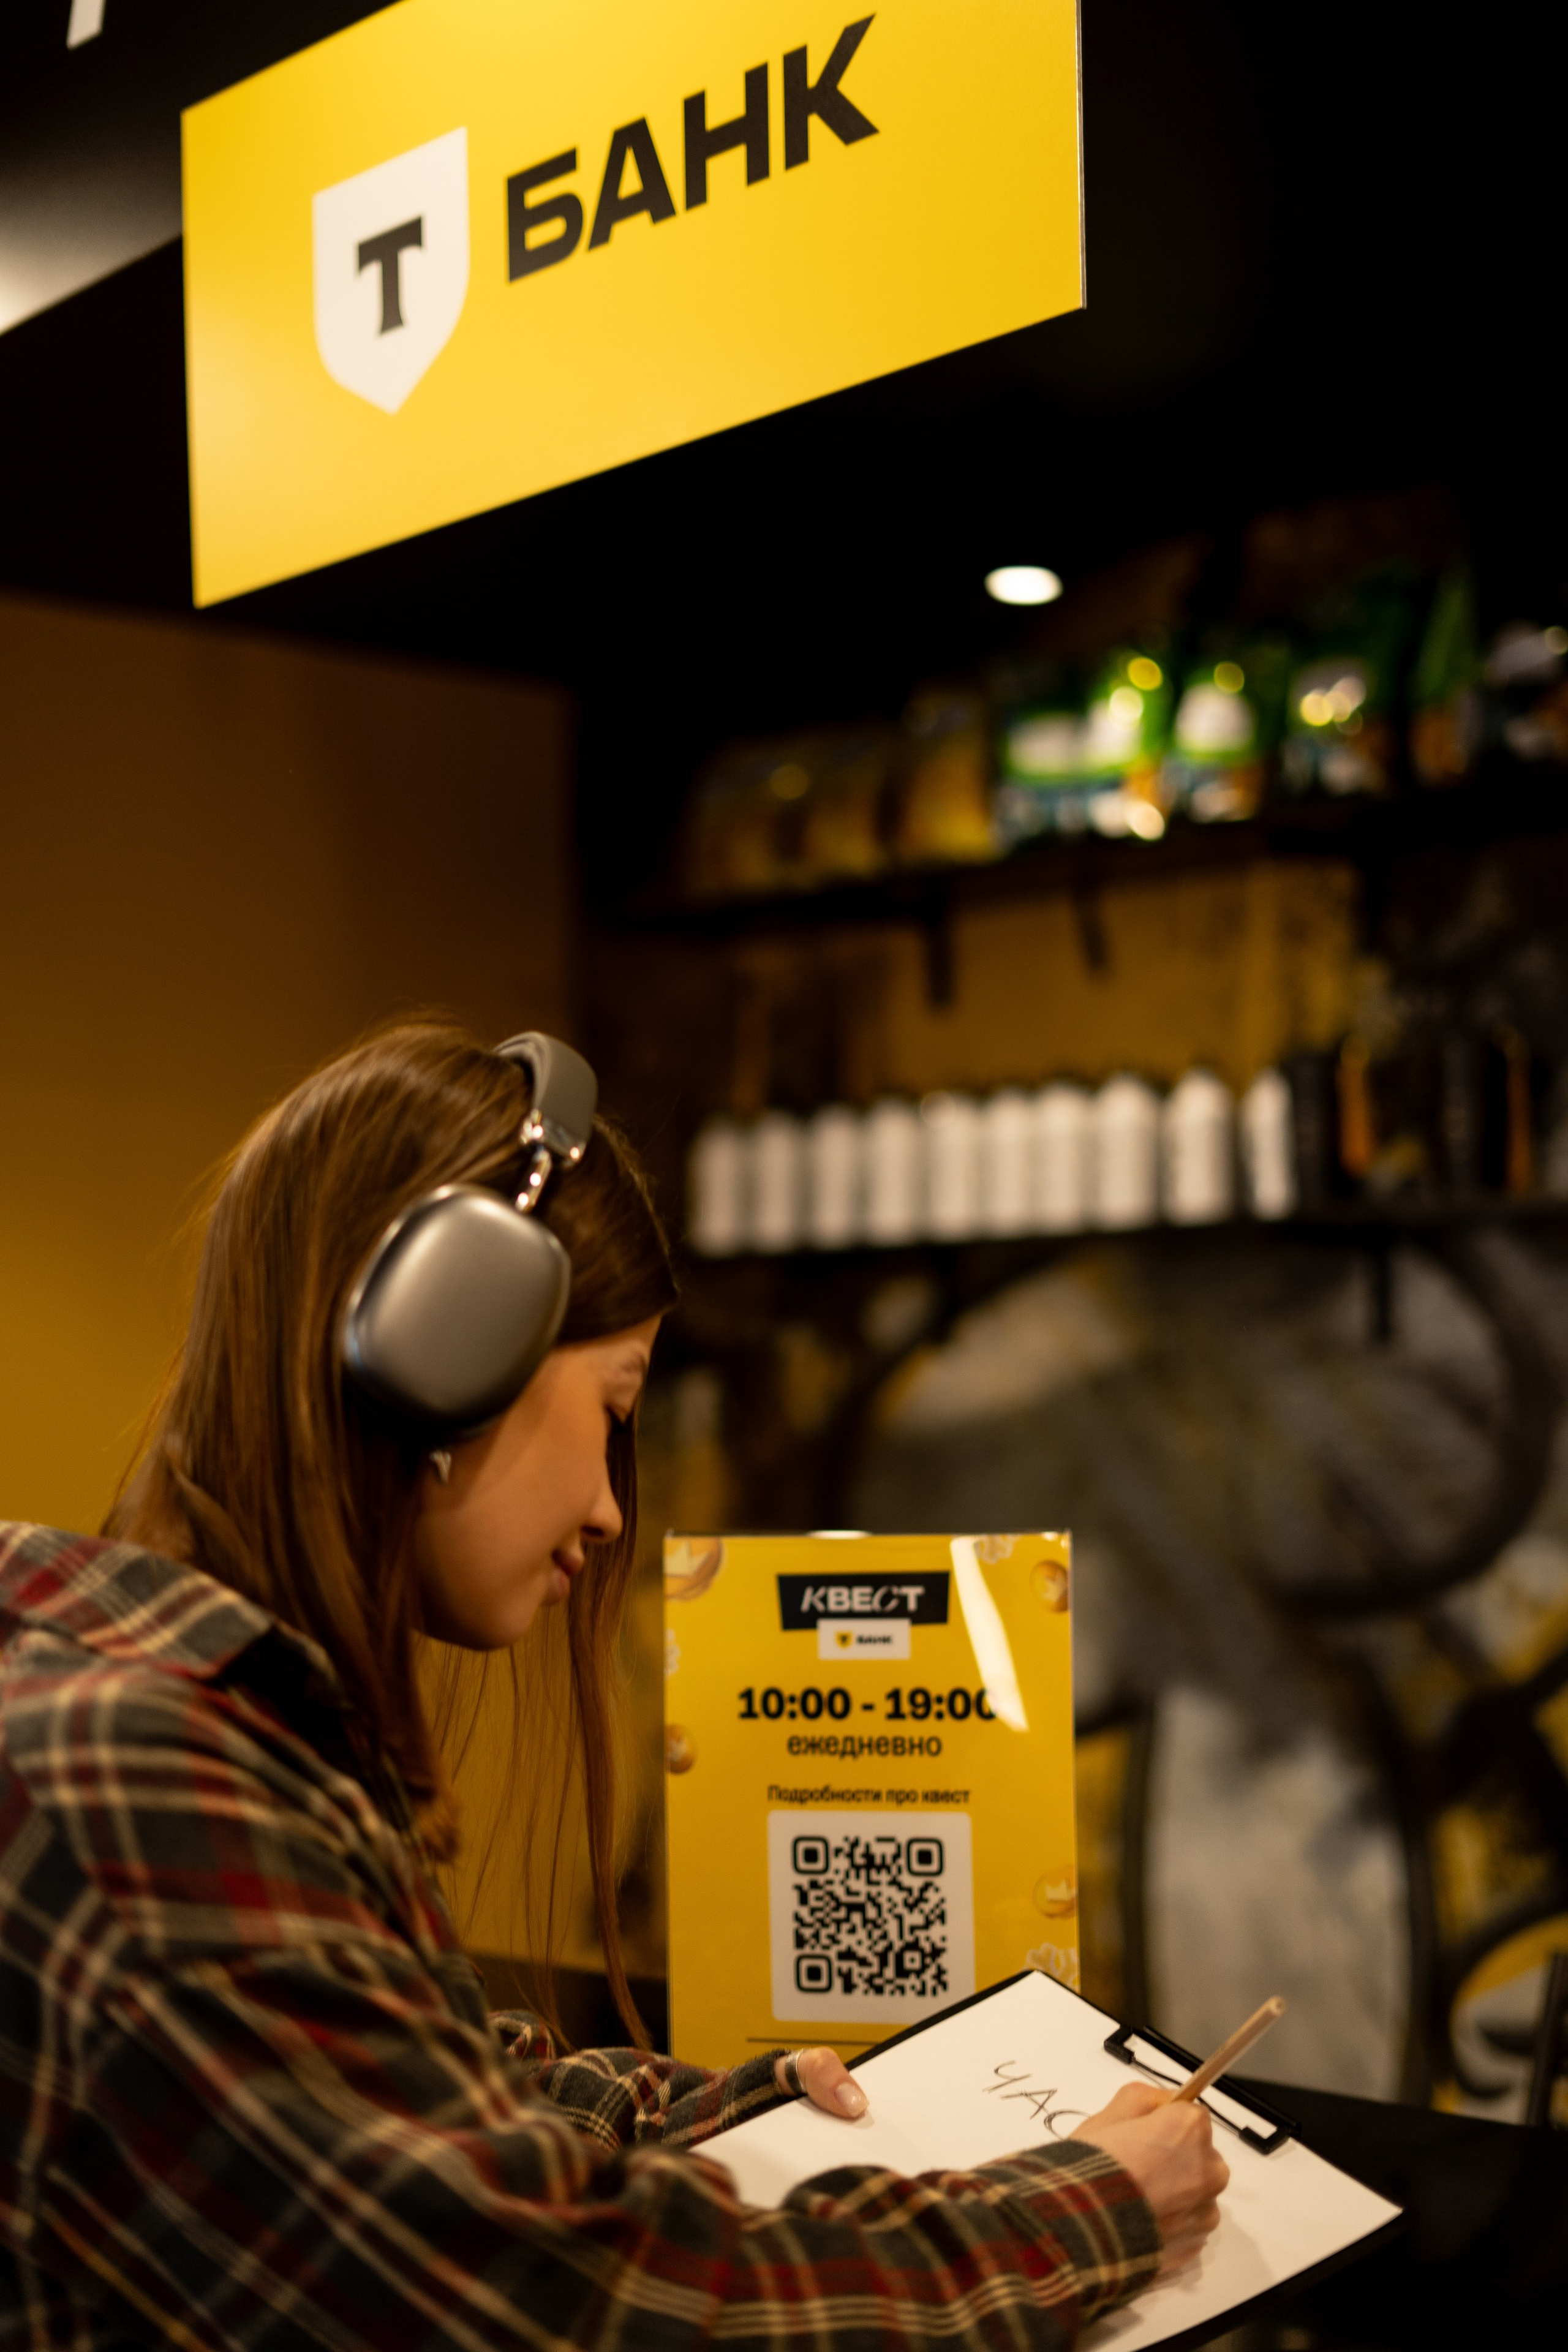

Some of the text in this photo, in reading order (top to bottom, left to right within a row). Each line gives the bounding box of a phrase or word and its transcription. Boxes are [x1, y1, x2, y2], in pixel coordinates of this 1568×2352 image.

[506, 12, 881, 285] БАНК
[800, 1585, 925, 1613] КВЕСТ
[738, 1687, 851, 1721] 10:00
[885, 1687, 997, 1721] 19:00
[787, 1735, 942, 1760] ежедневно
[767, 1785, 970, 1806] Подробности про квест
